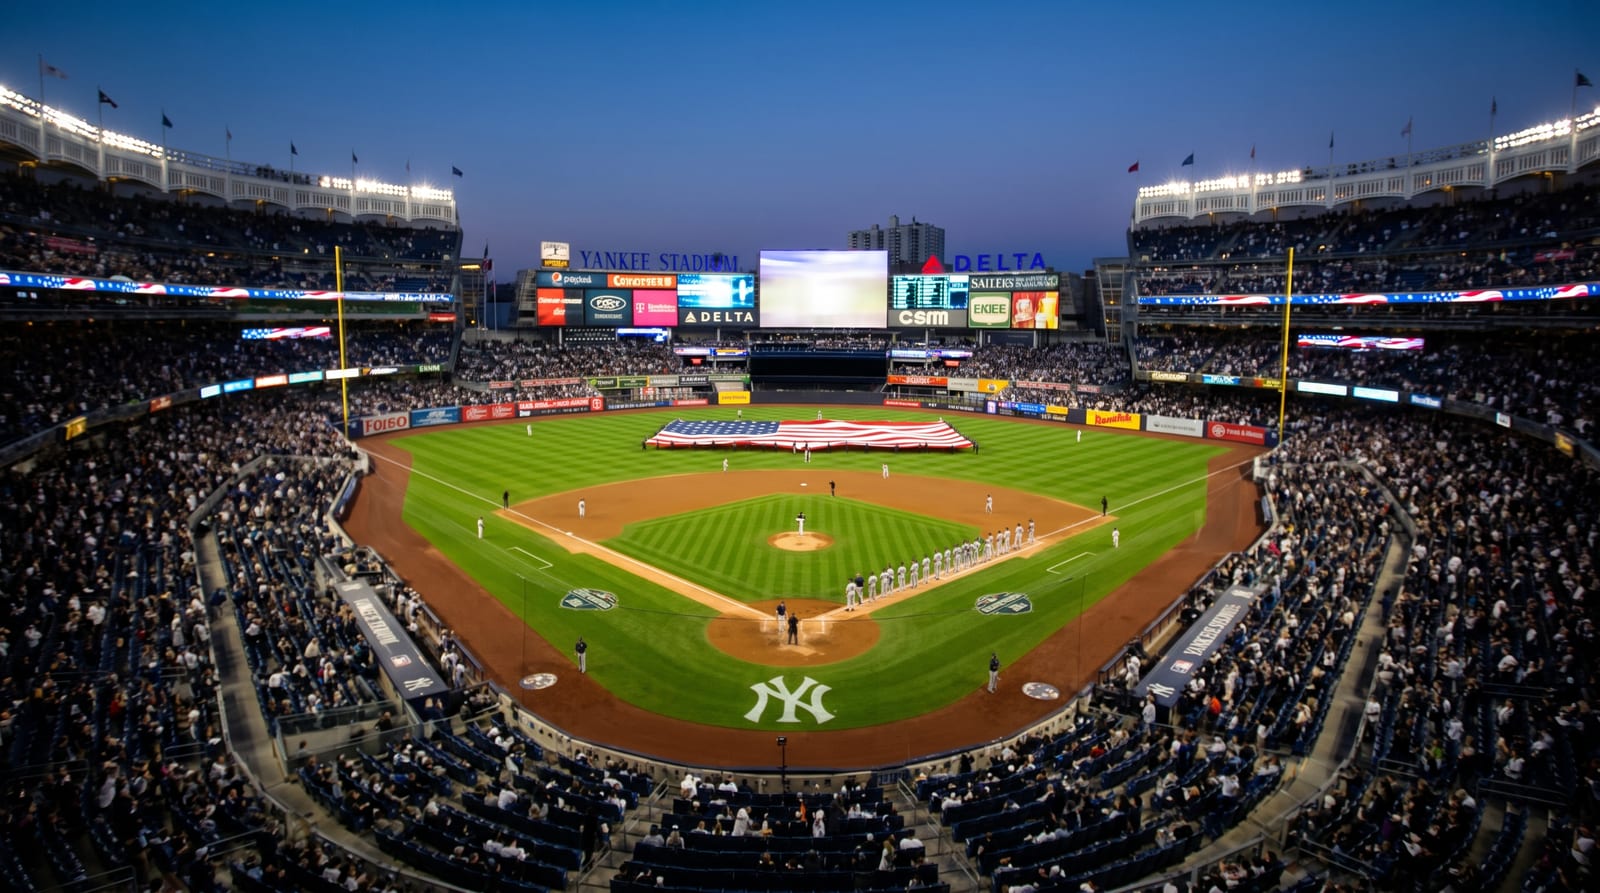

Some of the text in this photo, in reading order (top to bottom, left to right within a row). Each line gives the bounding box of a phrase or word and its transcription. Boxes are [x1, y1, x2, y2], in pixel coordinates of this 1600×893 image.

[580, 251, 650, 270] YANKEE
[659, 252, 738, 272] STADIUM
[954, 252, 1046, 272] DELTA
[701, 311, 754, 322] DELTA
[743, 675, 836, 724] NY
